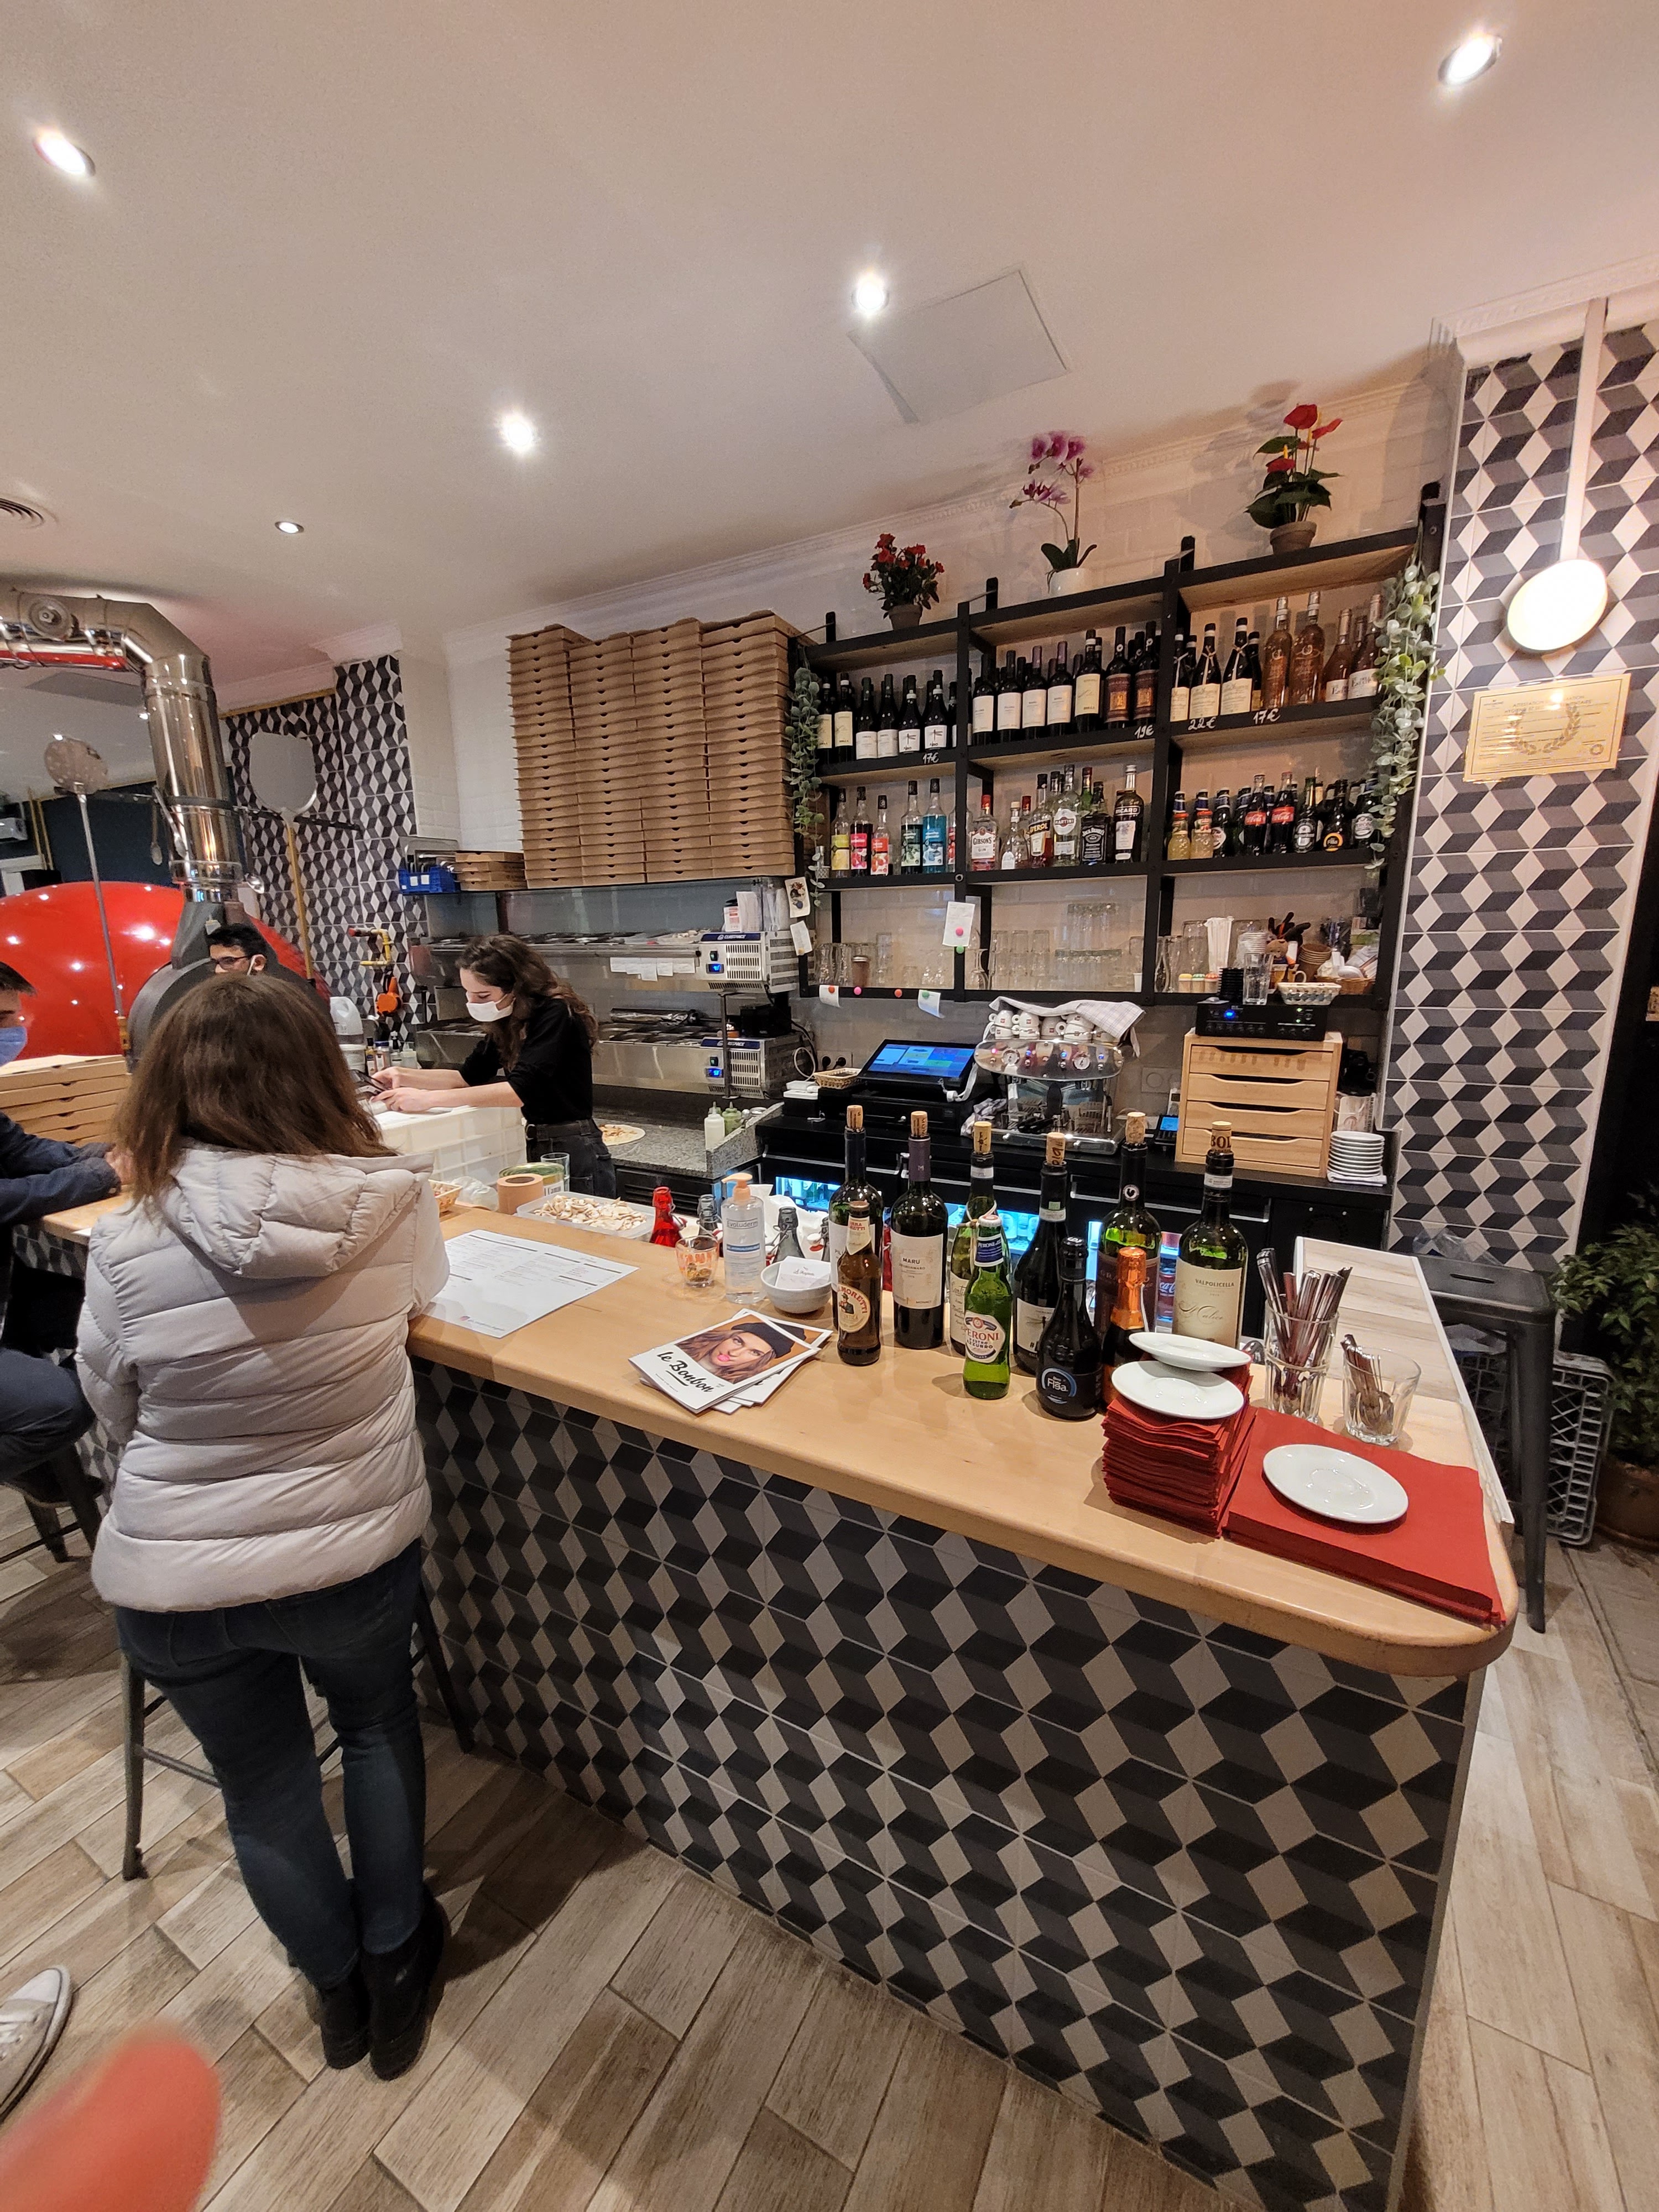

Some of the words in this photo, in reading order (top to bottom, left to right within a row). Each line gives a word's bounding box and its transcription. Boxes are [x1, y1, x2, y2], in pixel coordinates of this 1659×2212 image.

[1253, 708, 1281, 724] 17€
[1188, 717, 1217, 731] 22€
[1134, 725, 1154, 738] 19€
[922, 752, 940, 764] 17€
[973, 837, 992, 845] GIBSON'S
[1195, 1278, 1235, 1287] VALPOLICELLA
[841, 1286, 868, 1314] MORETTI
[963, 1327, 999, 1341] PERONI
[656, 1352, 674, 1362] le
[669, 1360, 714, 1392] Bonbon
